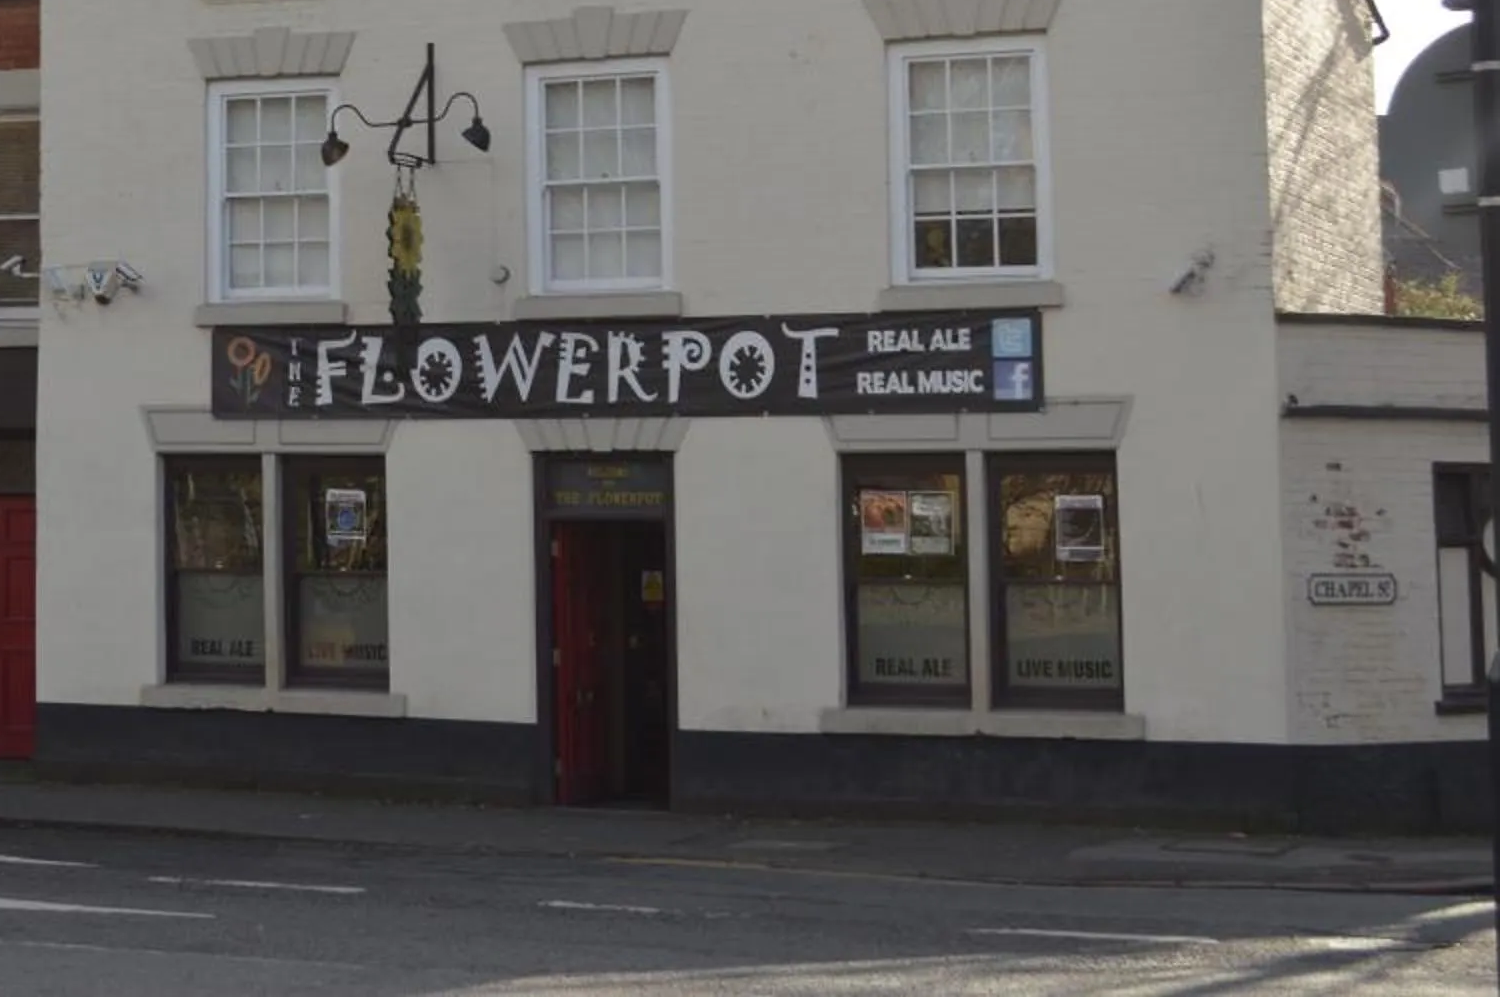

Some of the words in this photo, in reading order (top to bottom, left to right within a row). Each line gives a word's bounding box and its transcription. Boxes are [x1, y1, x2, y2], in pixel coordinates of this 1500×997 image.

[867, 330, 925, 353] REAL
[929, 328, 972, 351] ALE
[314, 323, 840, 405] FLOWERPOT
[857, 371, 915, 394] REAL
[917, 370, 984, 394] MUSIC
[1315, 581, 1374, 598] CHAPEL
[875, 658, 915, 676] REAL
[921, 659, 950, 677] ALE
[1017, 660, 1053, 678] LIVE
[1058, 660, 1113, 679] MUSIC
